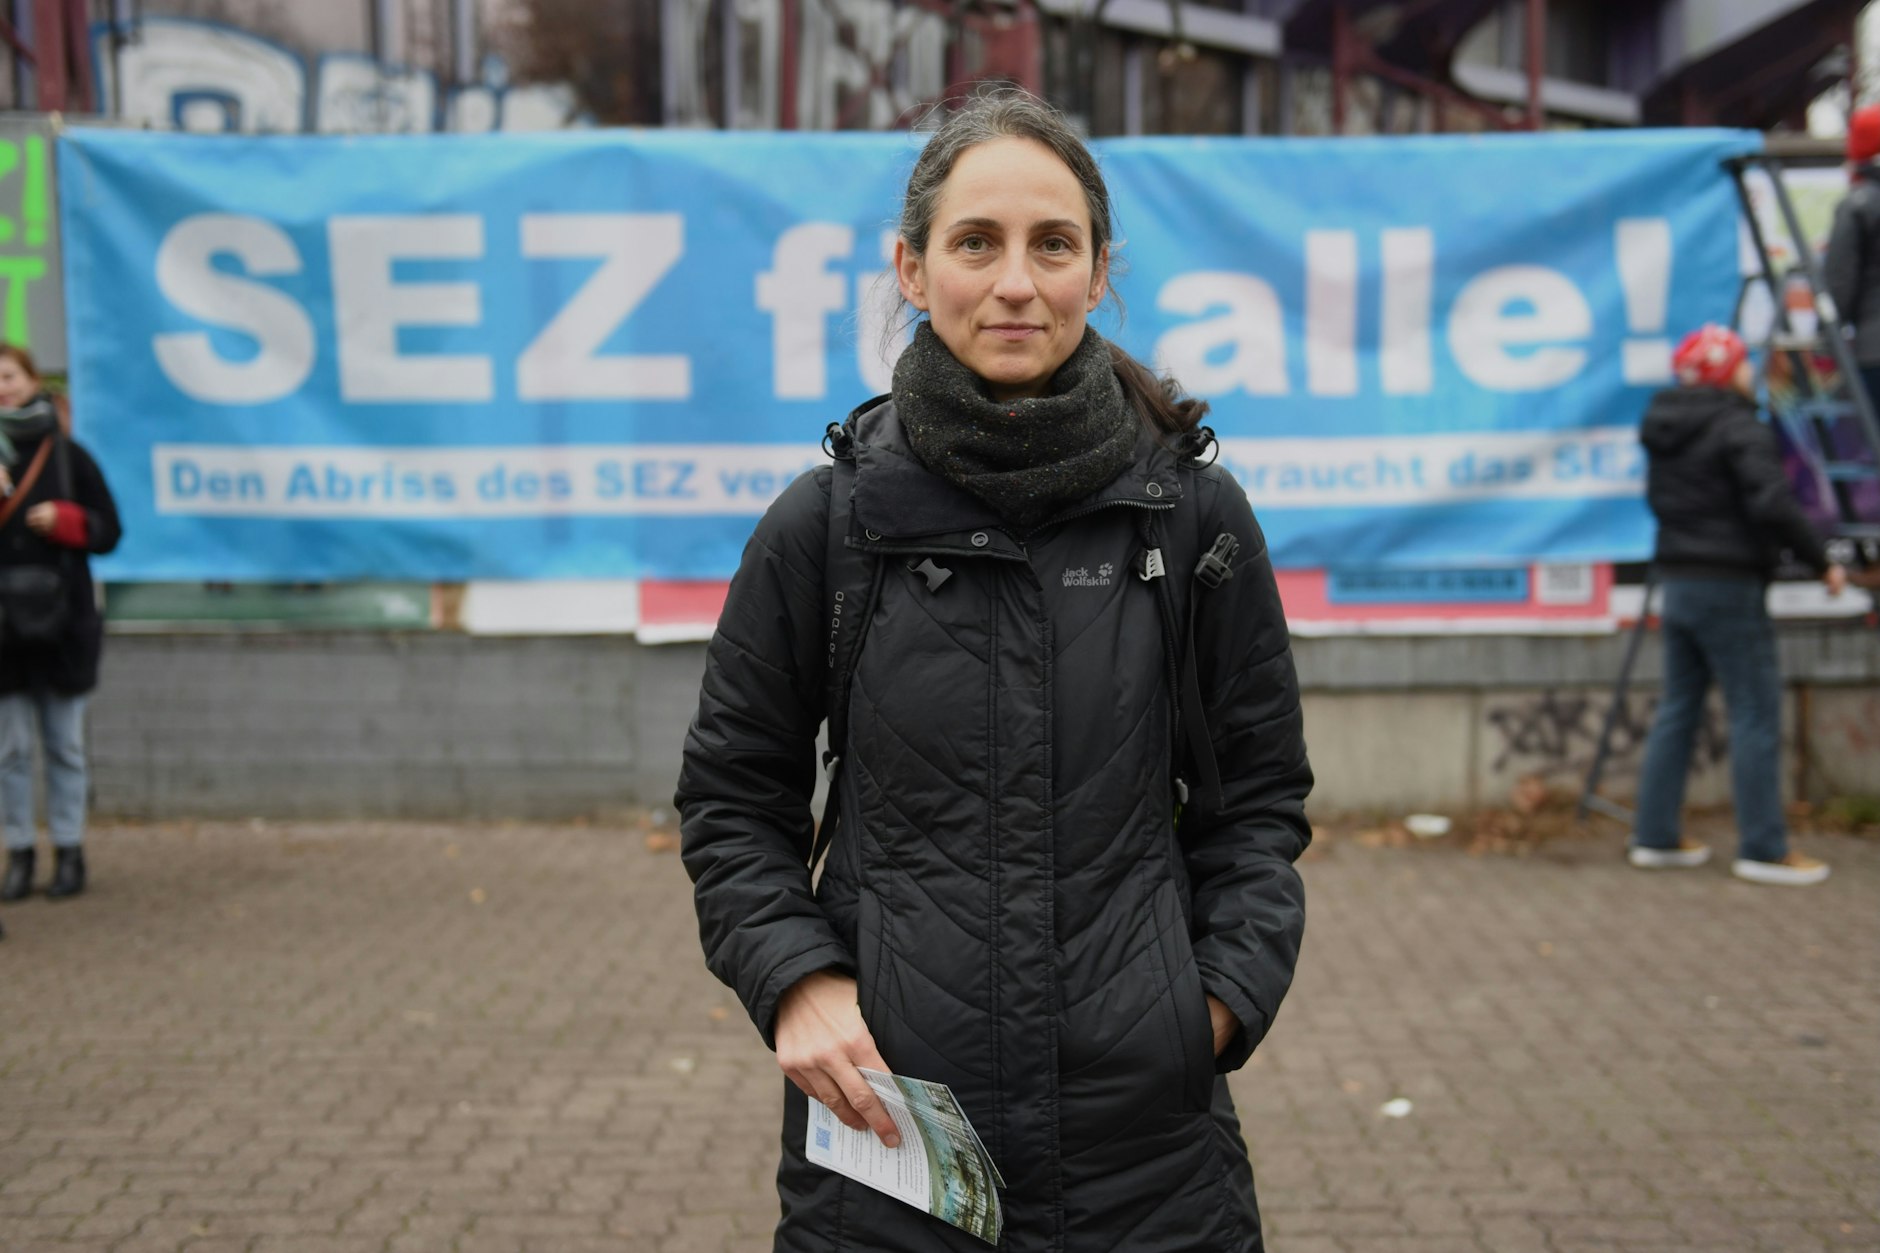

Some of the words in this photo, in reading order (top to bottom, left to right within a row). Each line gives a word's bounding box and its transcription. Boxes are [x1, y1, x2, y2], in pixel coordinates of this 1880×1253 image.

[152, 213, 692, 405] SEZ
[1154, 218, 1673, 395] alle!
[170, 462, 264, 500] Den
[287, 462, 455, 501] Abriss
[478, 463, 573, 501] des
[595, 460, 697, 499] SEZ
[1448, 451, 1535, 487] das
[1062, 567, 1089, 578] Jack
[1062, 575, 1111, 588] Wolfskin
